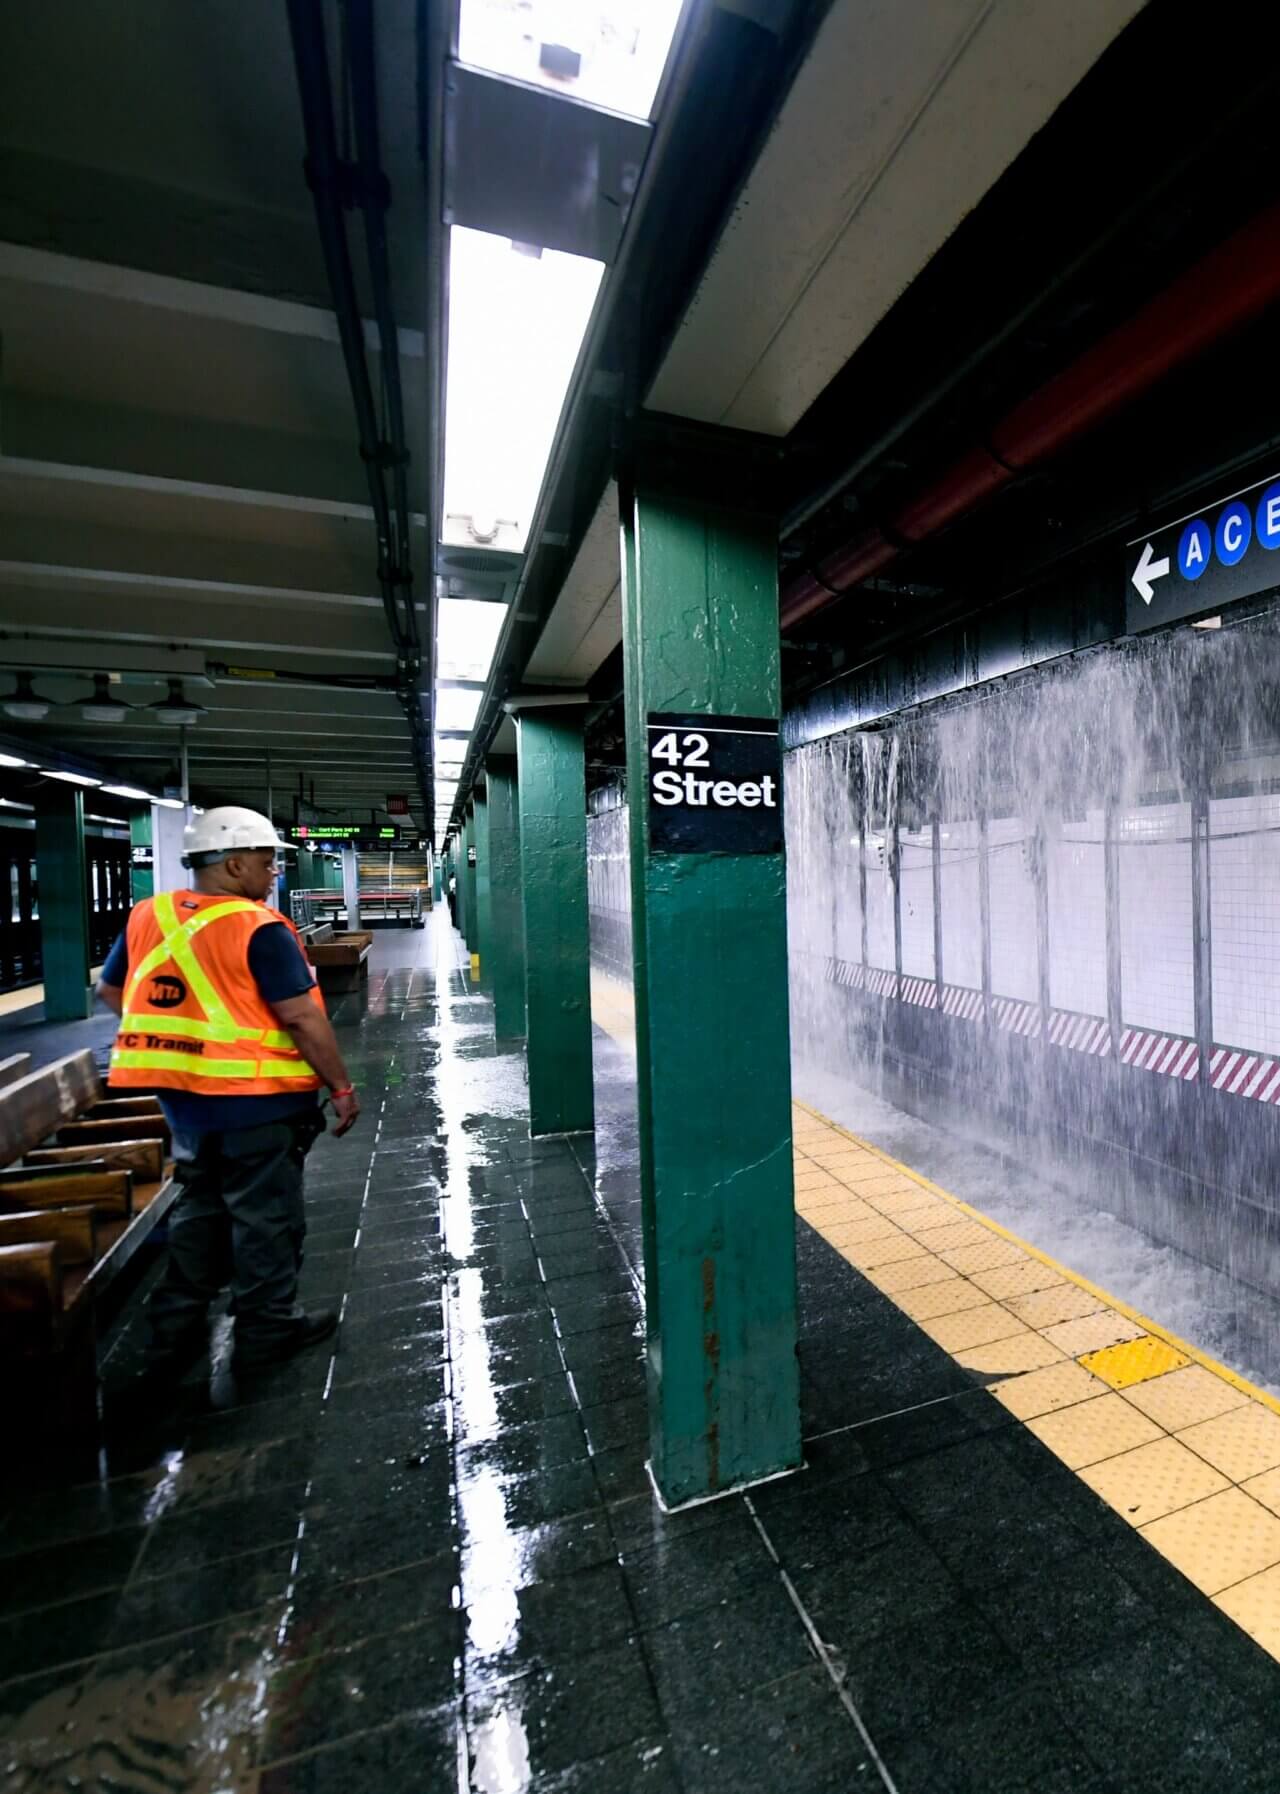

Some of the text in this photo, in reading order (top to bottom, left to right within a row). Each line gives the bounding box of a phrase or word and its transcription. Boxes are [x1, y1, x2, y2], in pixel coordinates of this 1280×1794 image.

[1185, 531, 1204, 568] A
[1222, 514, 1243, 553] C
[651, 732, 710, 768] 42
[652, 770, 777, 807] Street
[132, 847, 147, 856] 42
[144, 1034, 205, 1056] Transit
